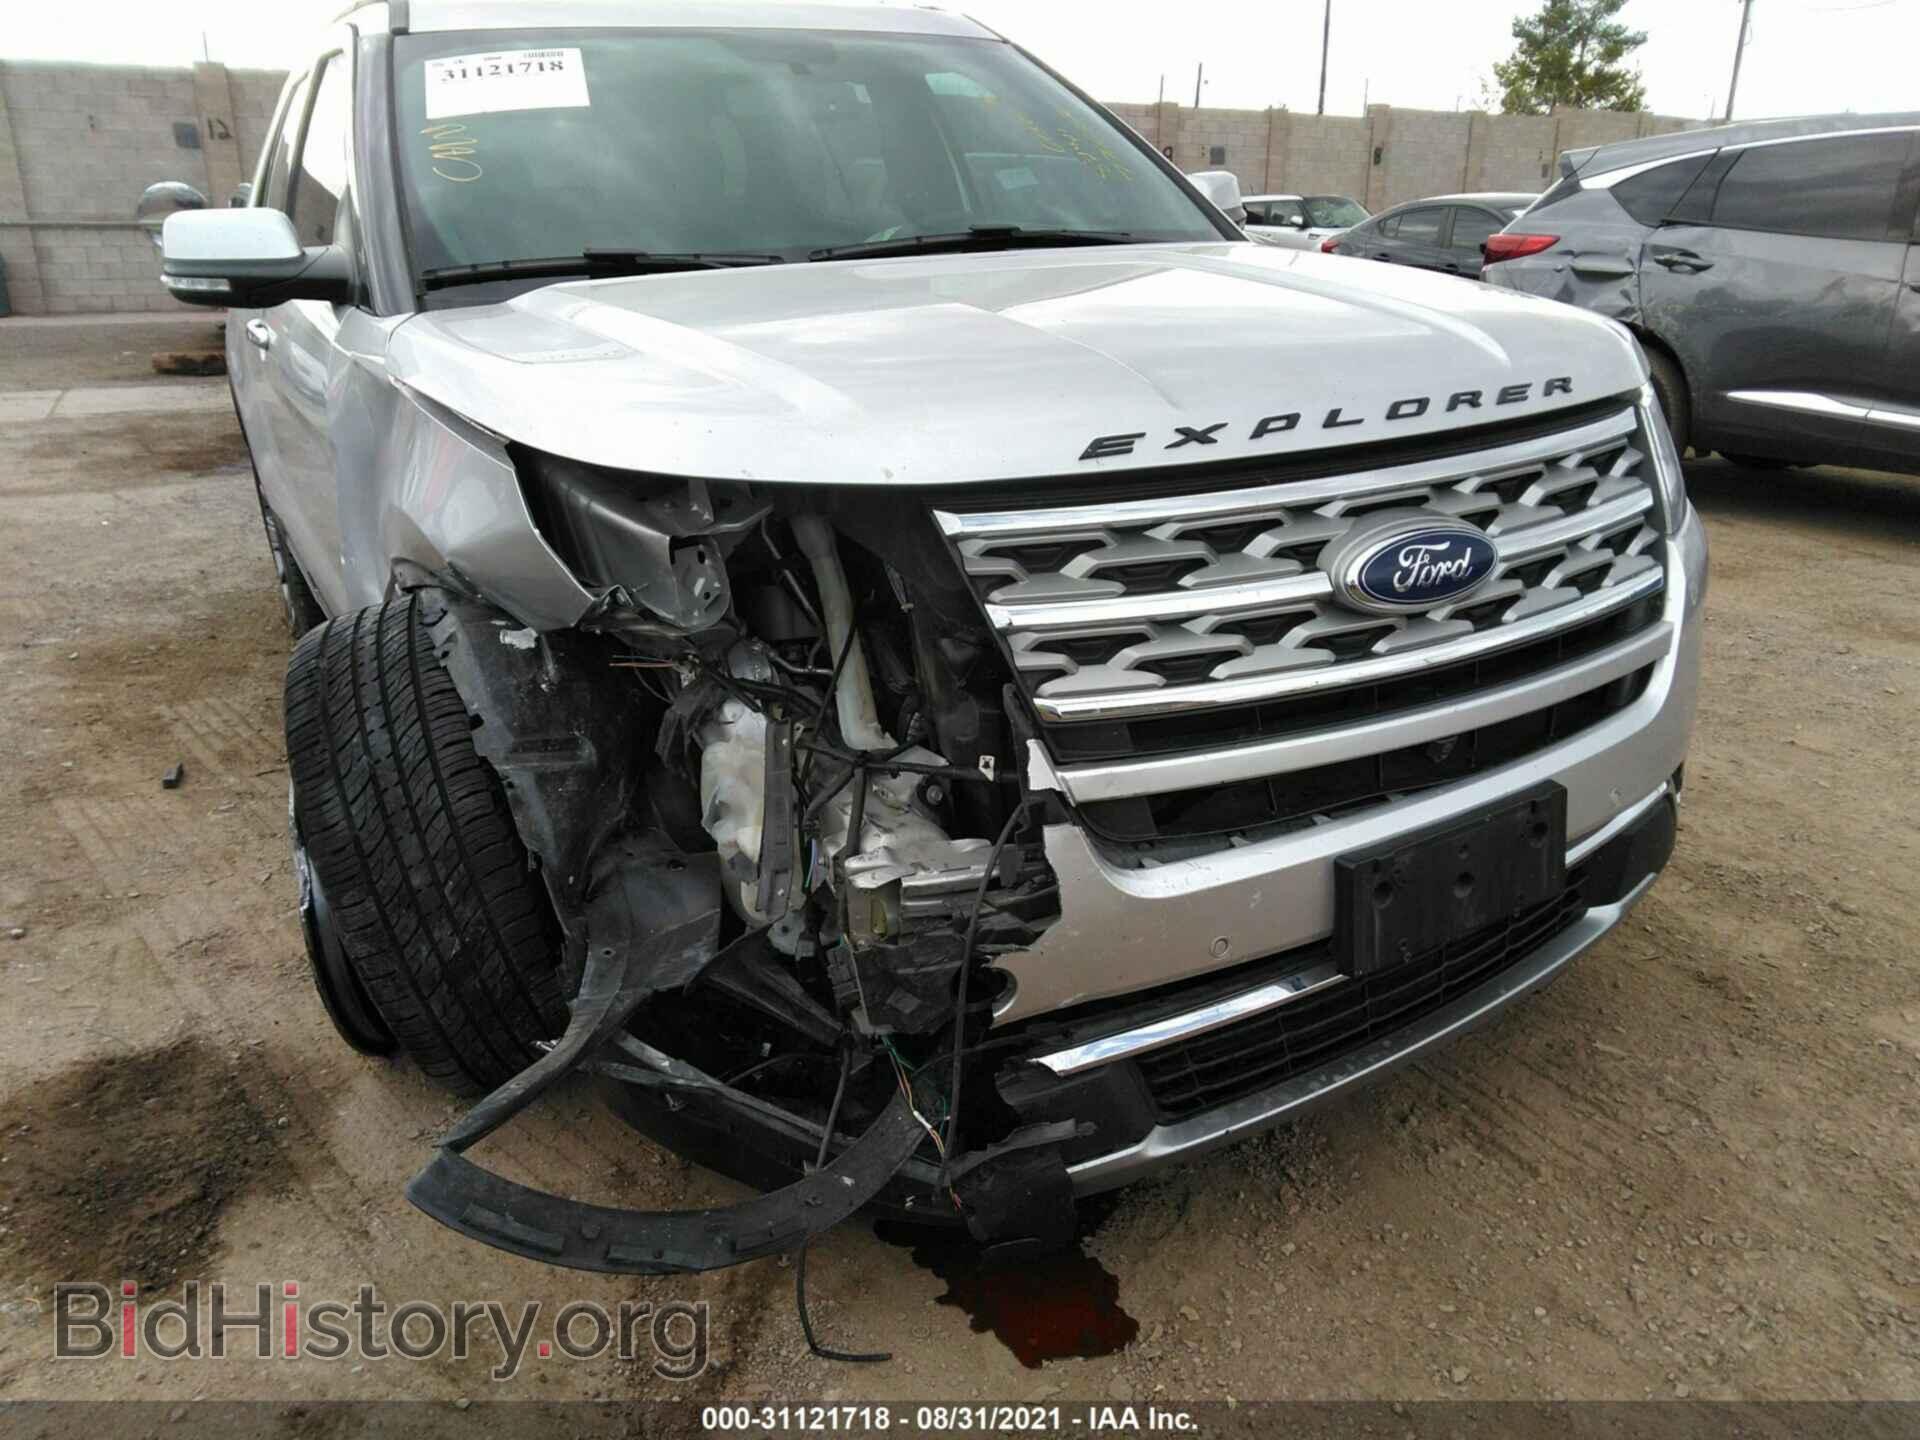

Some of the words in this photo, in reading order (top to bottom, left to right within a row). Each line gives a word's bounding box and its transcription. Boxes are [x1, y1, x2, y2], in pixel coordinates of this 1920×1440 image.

[440, 60, 565, 83] 31121718
[1078, 375, 1574, 461] EXPLORER
[1393, 540, 1473, 592] Ford
